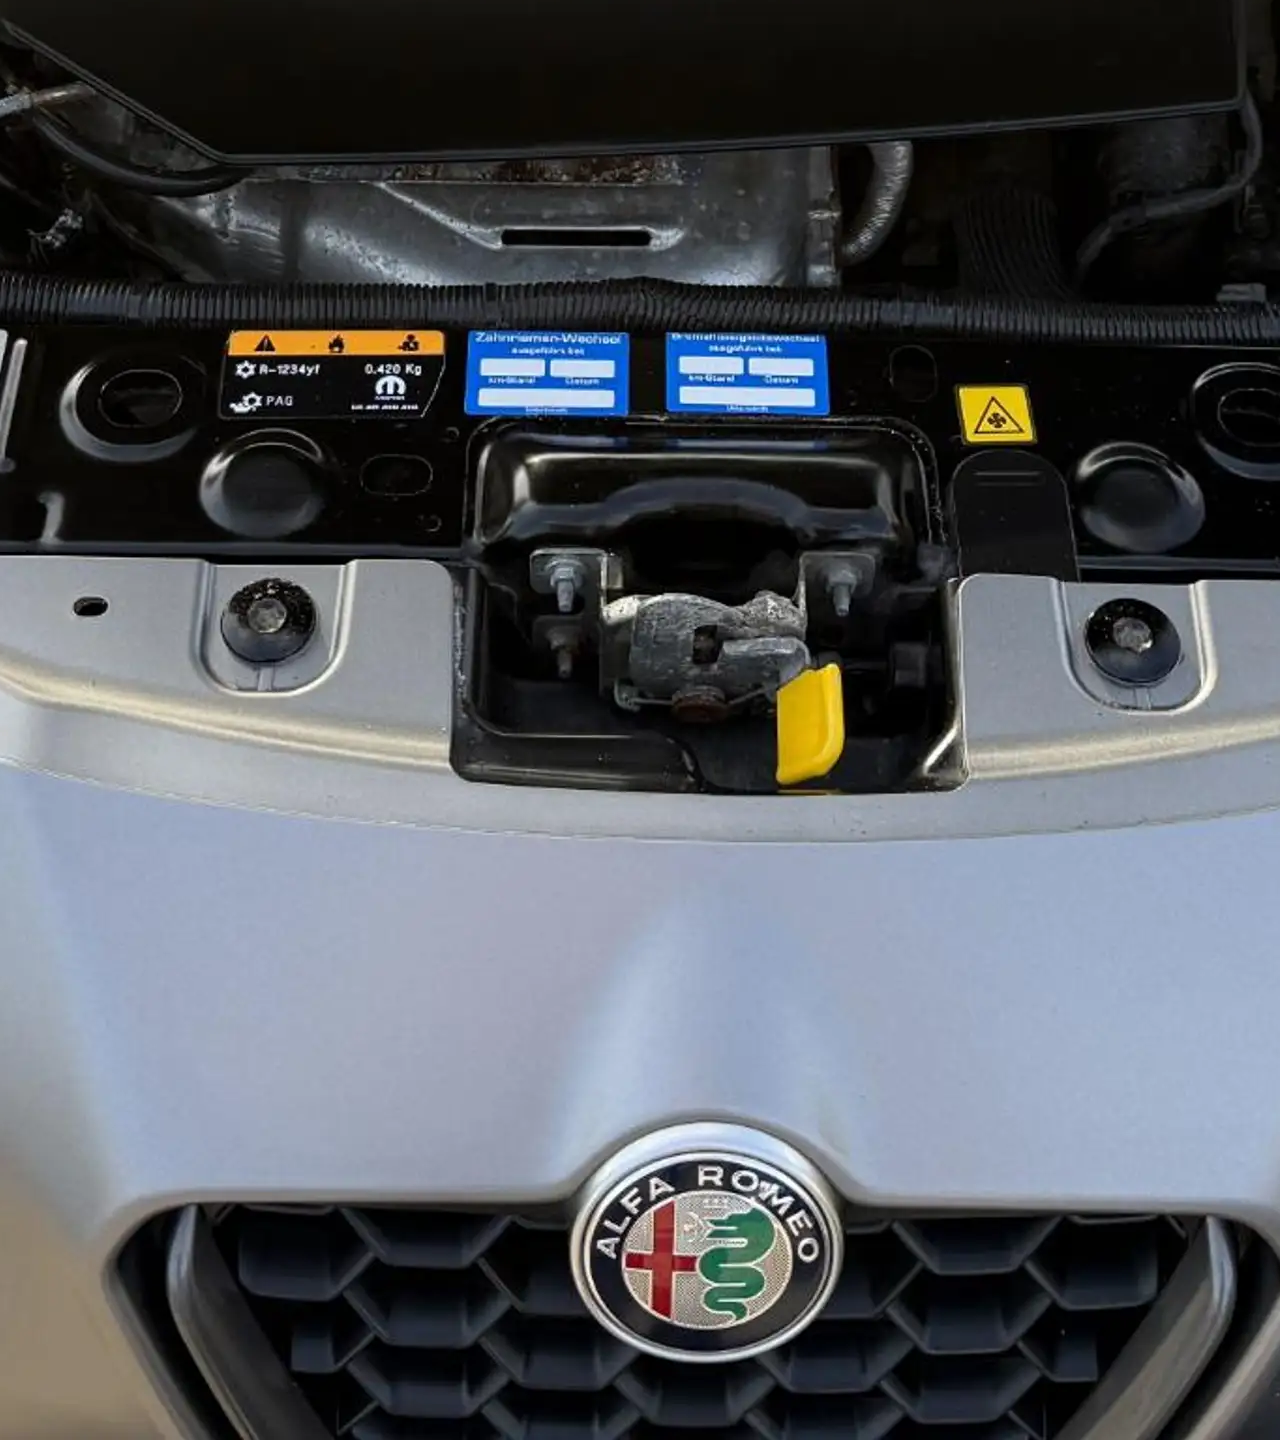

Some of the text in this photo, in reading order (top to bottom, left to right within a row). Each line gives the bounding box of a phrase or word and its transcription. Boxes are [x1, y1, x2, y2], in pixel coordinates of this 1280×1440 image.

[364, 363, 402, 375] 0.420
[405, 363, 422, 376] Kg
[265, 395, 294, 407] PAG
[596, 1164, 821, 1264] ALFA ROMEO
